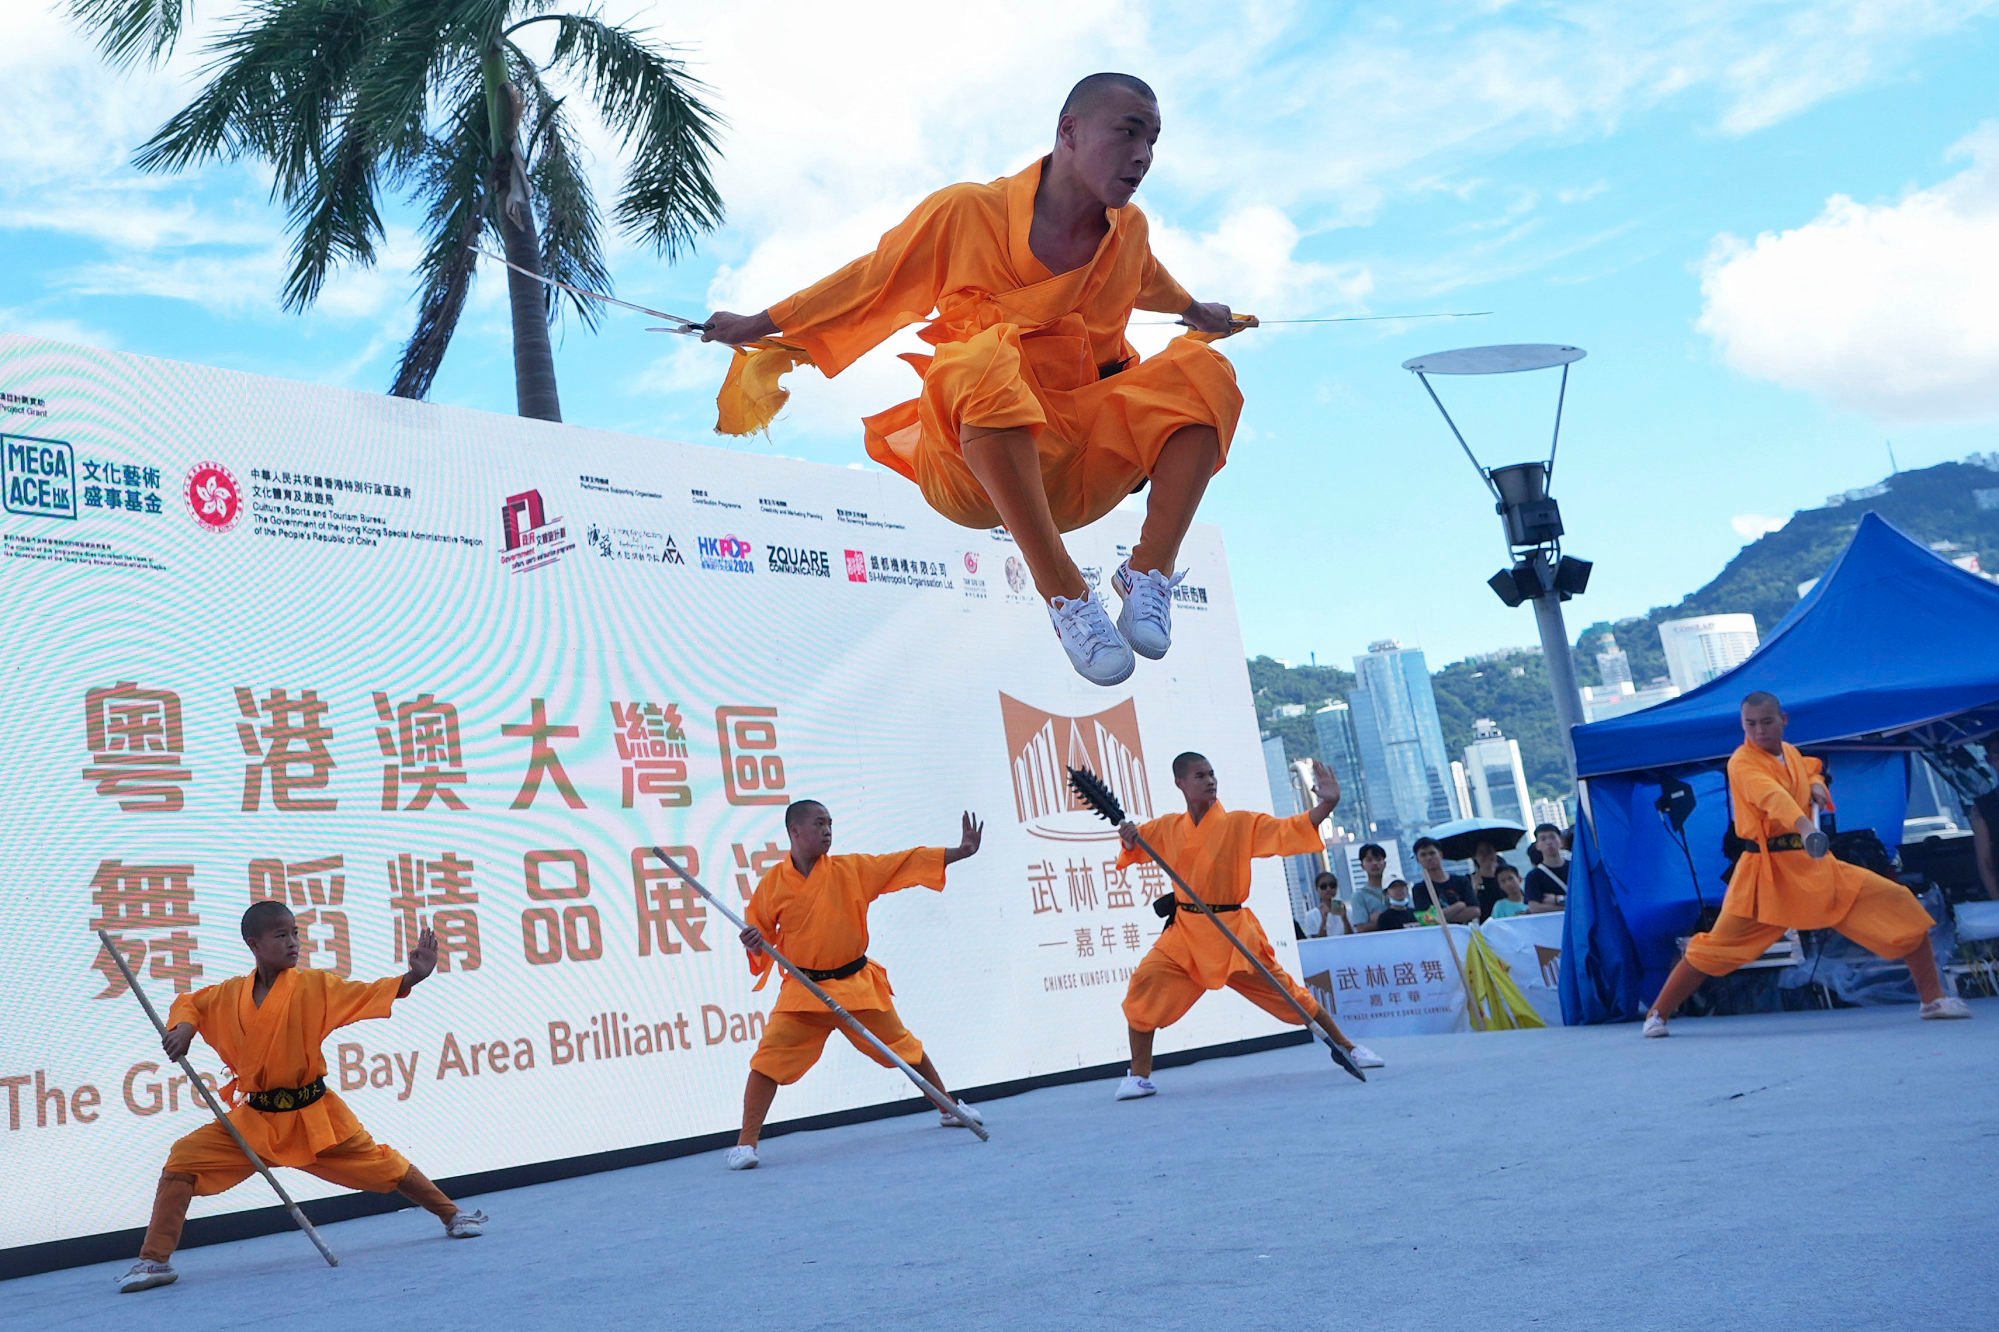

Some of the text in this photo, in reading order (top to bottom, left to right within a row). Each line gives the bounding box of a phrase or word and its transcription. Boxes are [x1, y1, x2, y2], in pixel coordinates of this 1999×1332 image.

[8, 443, 68, 478] MEGA
[82, 459, 160, 489] 文化藝術
[10, 476, 70, 508] ACE HK
[84, 484, 163, 514] 盛事基金
[253, 501, 386, 525] Culture, Sports and Tourism Bureau
[253, 514, 268, 523] The
[270, 516, 316, 528] Government
[319, 521, 325, 529] of
[328, 522, 339, 531] the
[342, 524, 360, 535] Hong
[362, 526, 381, 537] Kong
[383, 528, 408, 539] Special
[460, 536, 483, 546] Region
[255, 527, 376, 546] of the People's Republic of China
[766, 545, 829, 569] ZQUARE
[769, 562, 830, 577] COMMUNICATIONS
[871, 555, 947, 577] 銀都機構有限公司
[907, 575, 943, 588] Organisation
[82, 681, 790, 812] 粵港澳大灣區
[1027, 856, 1172, 915] 武林盛舞
[1074, 922, 1140, 958] 嘉年華
[1044, 973, 1077, 992] CHINESE
[1080, 970, 1110, 987] KUNGFU
[1119, 966, 1138, 982] DAN
[1336, 960, 1446, 991] 武林盛舞
[1369, 990, 1421, 1008] 嘉年華
[1343, 1013, 1368, 1021] CHINESE
[0, 1004, 769, 1131] The Gre Bay Area Brilliant Dan
